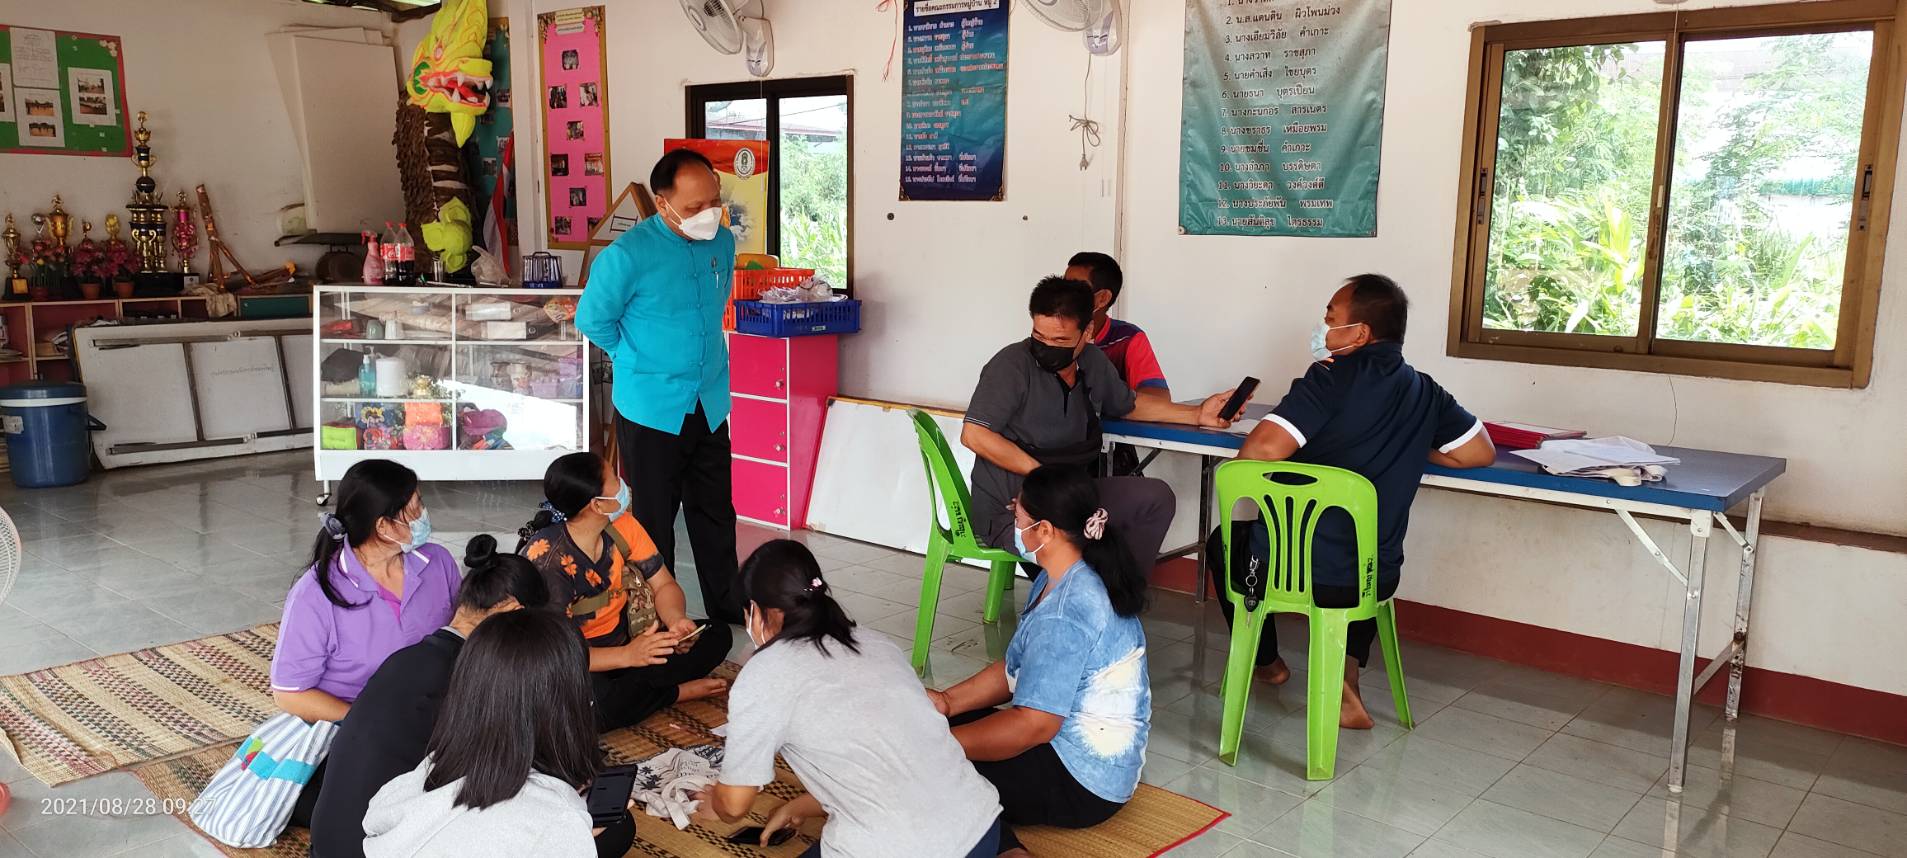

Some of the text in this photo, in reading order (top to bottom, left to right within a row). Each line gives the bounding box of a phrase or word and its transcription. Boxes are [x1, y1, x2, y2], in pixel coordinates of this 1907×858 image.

[1225, 15, 1233, 25] 2.
[1224, 35, 1233, 44] 3.
[1224, 53, 1232, 63] 4.
[1223, 72, 1231, 81] 5.
[1221, 90, 1230, 99] 6.
